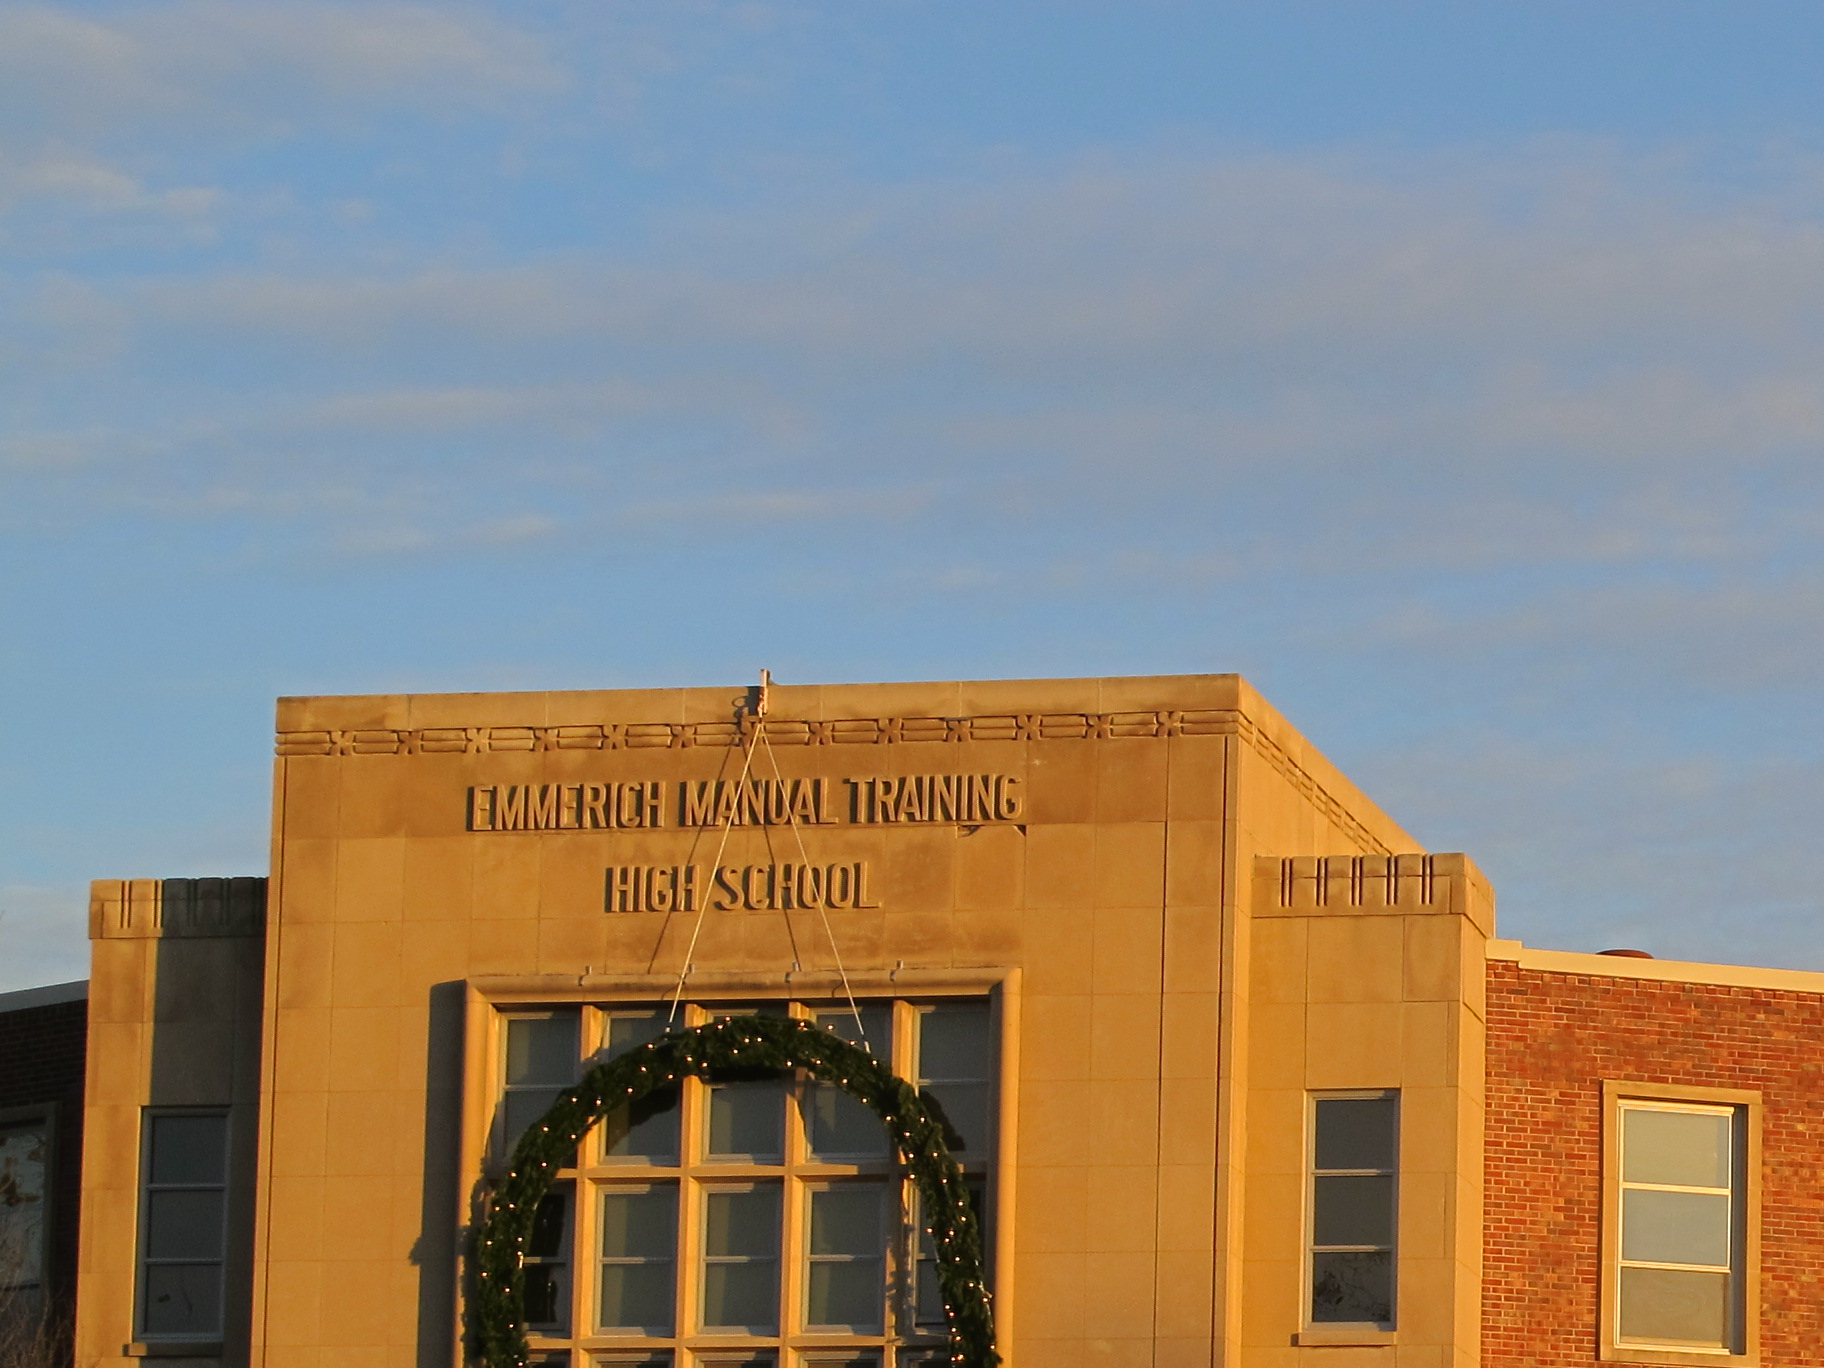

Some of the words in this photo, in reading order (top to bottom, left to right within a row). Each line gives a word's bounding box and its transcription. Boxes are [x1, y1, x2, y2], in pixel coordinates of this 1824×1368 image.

[467, 781, 666, 831] EMMERICH
[680, 777, 839, 827] MANUAL
[848, 773, 1024, 823] TRAINING
[605, 864, 701, 912] HIGH
[716, 861, 881, 911] SCHOOL
